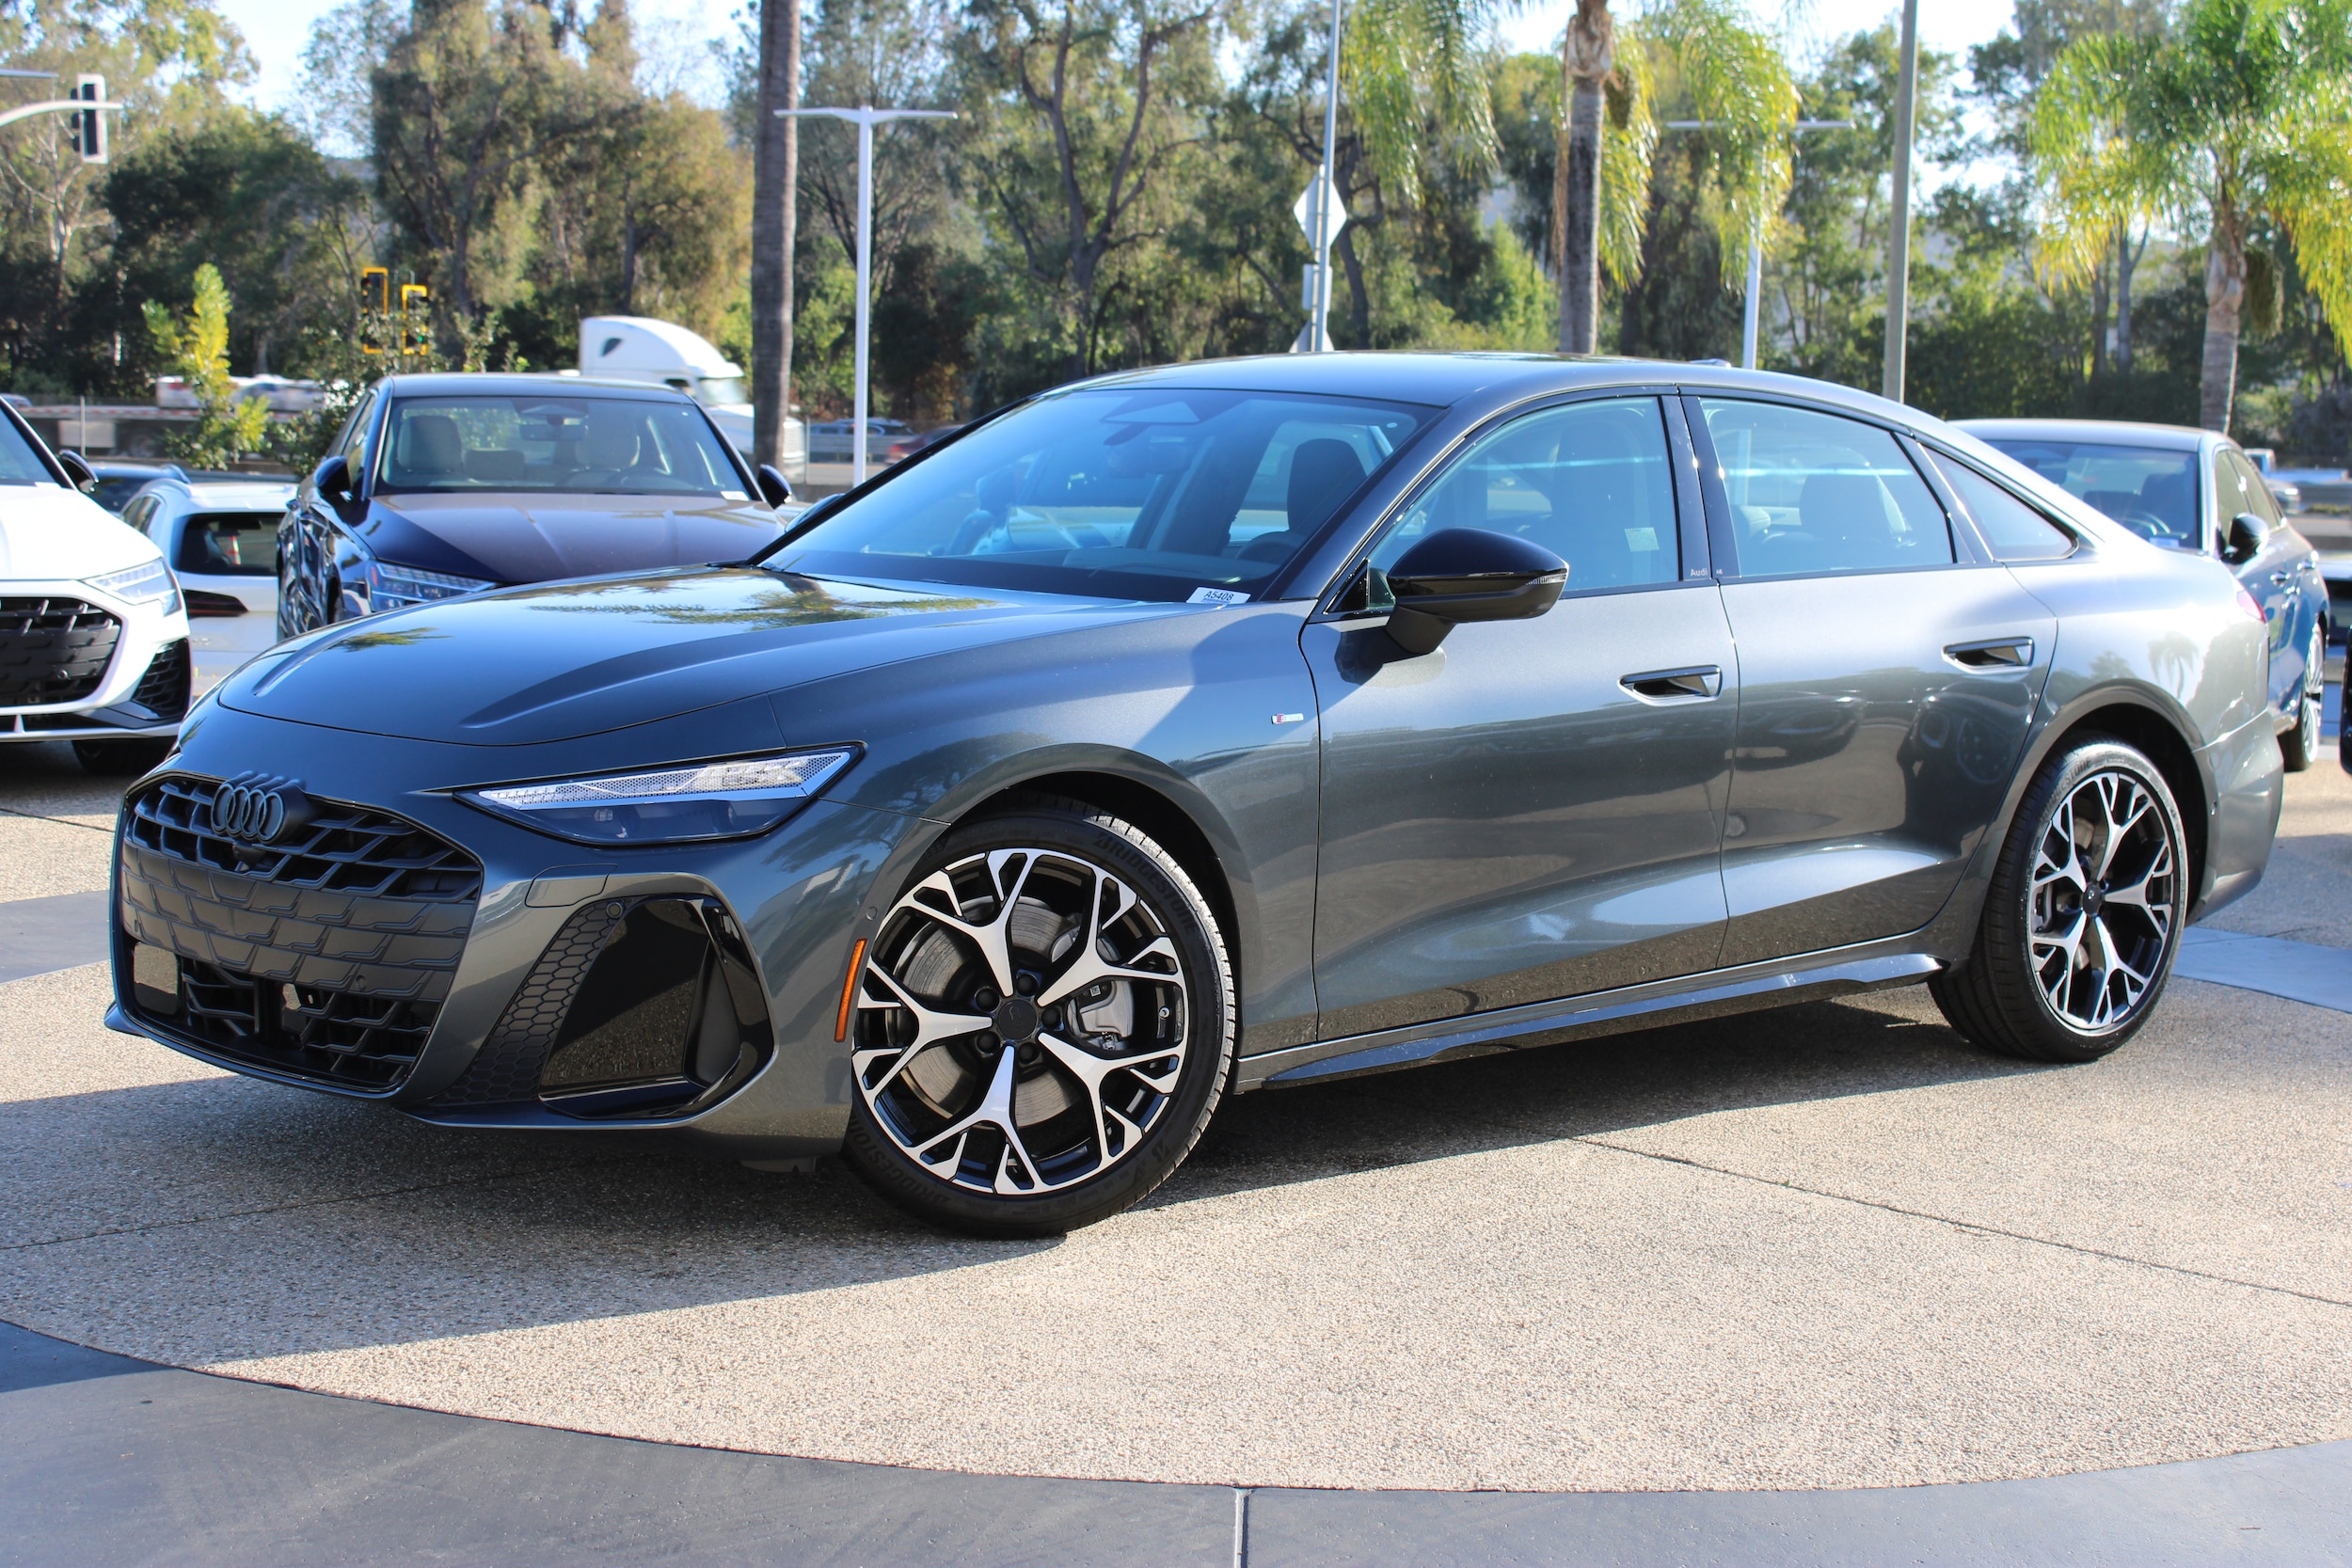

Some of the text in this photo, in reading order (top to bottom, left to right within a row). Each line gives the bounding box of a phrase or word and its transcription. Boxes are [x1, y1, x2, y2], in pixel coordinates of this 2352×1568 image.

[1204, 591, 1234, 601] A5408
[1690, 567, 1708, 577] Audi
[1092, 832, 1198, 934] BRIDGESTONE
[849, 1114, 951, 1207] BRIDGESTON
